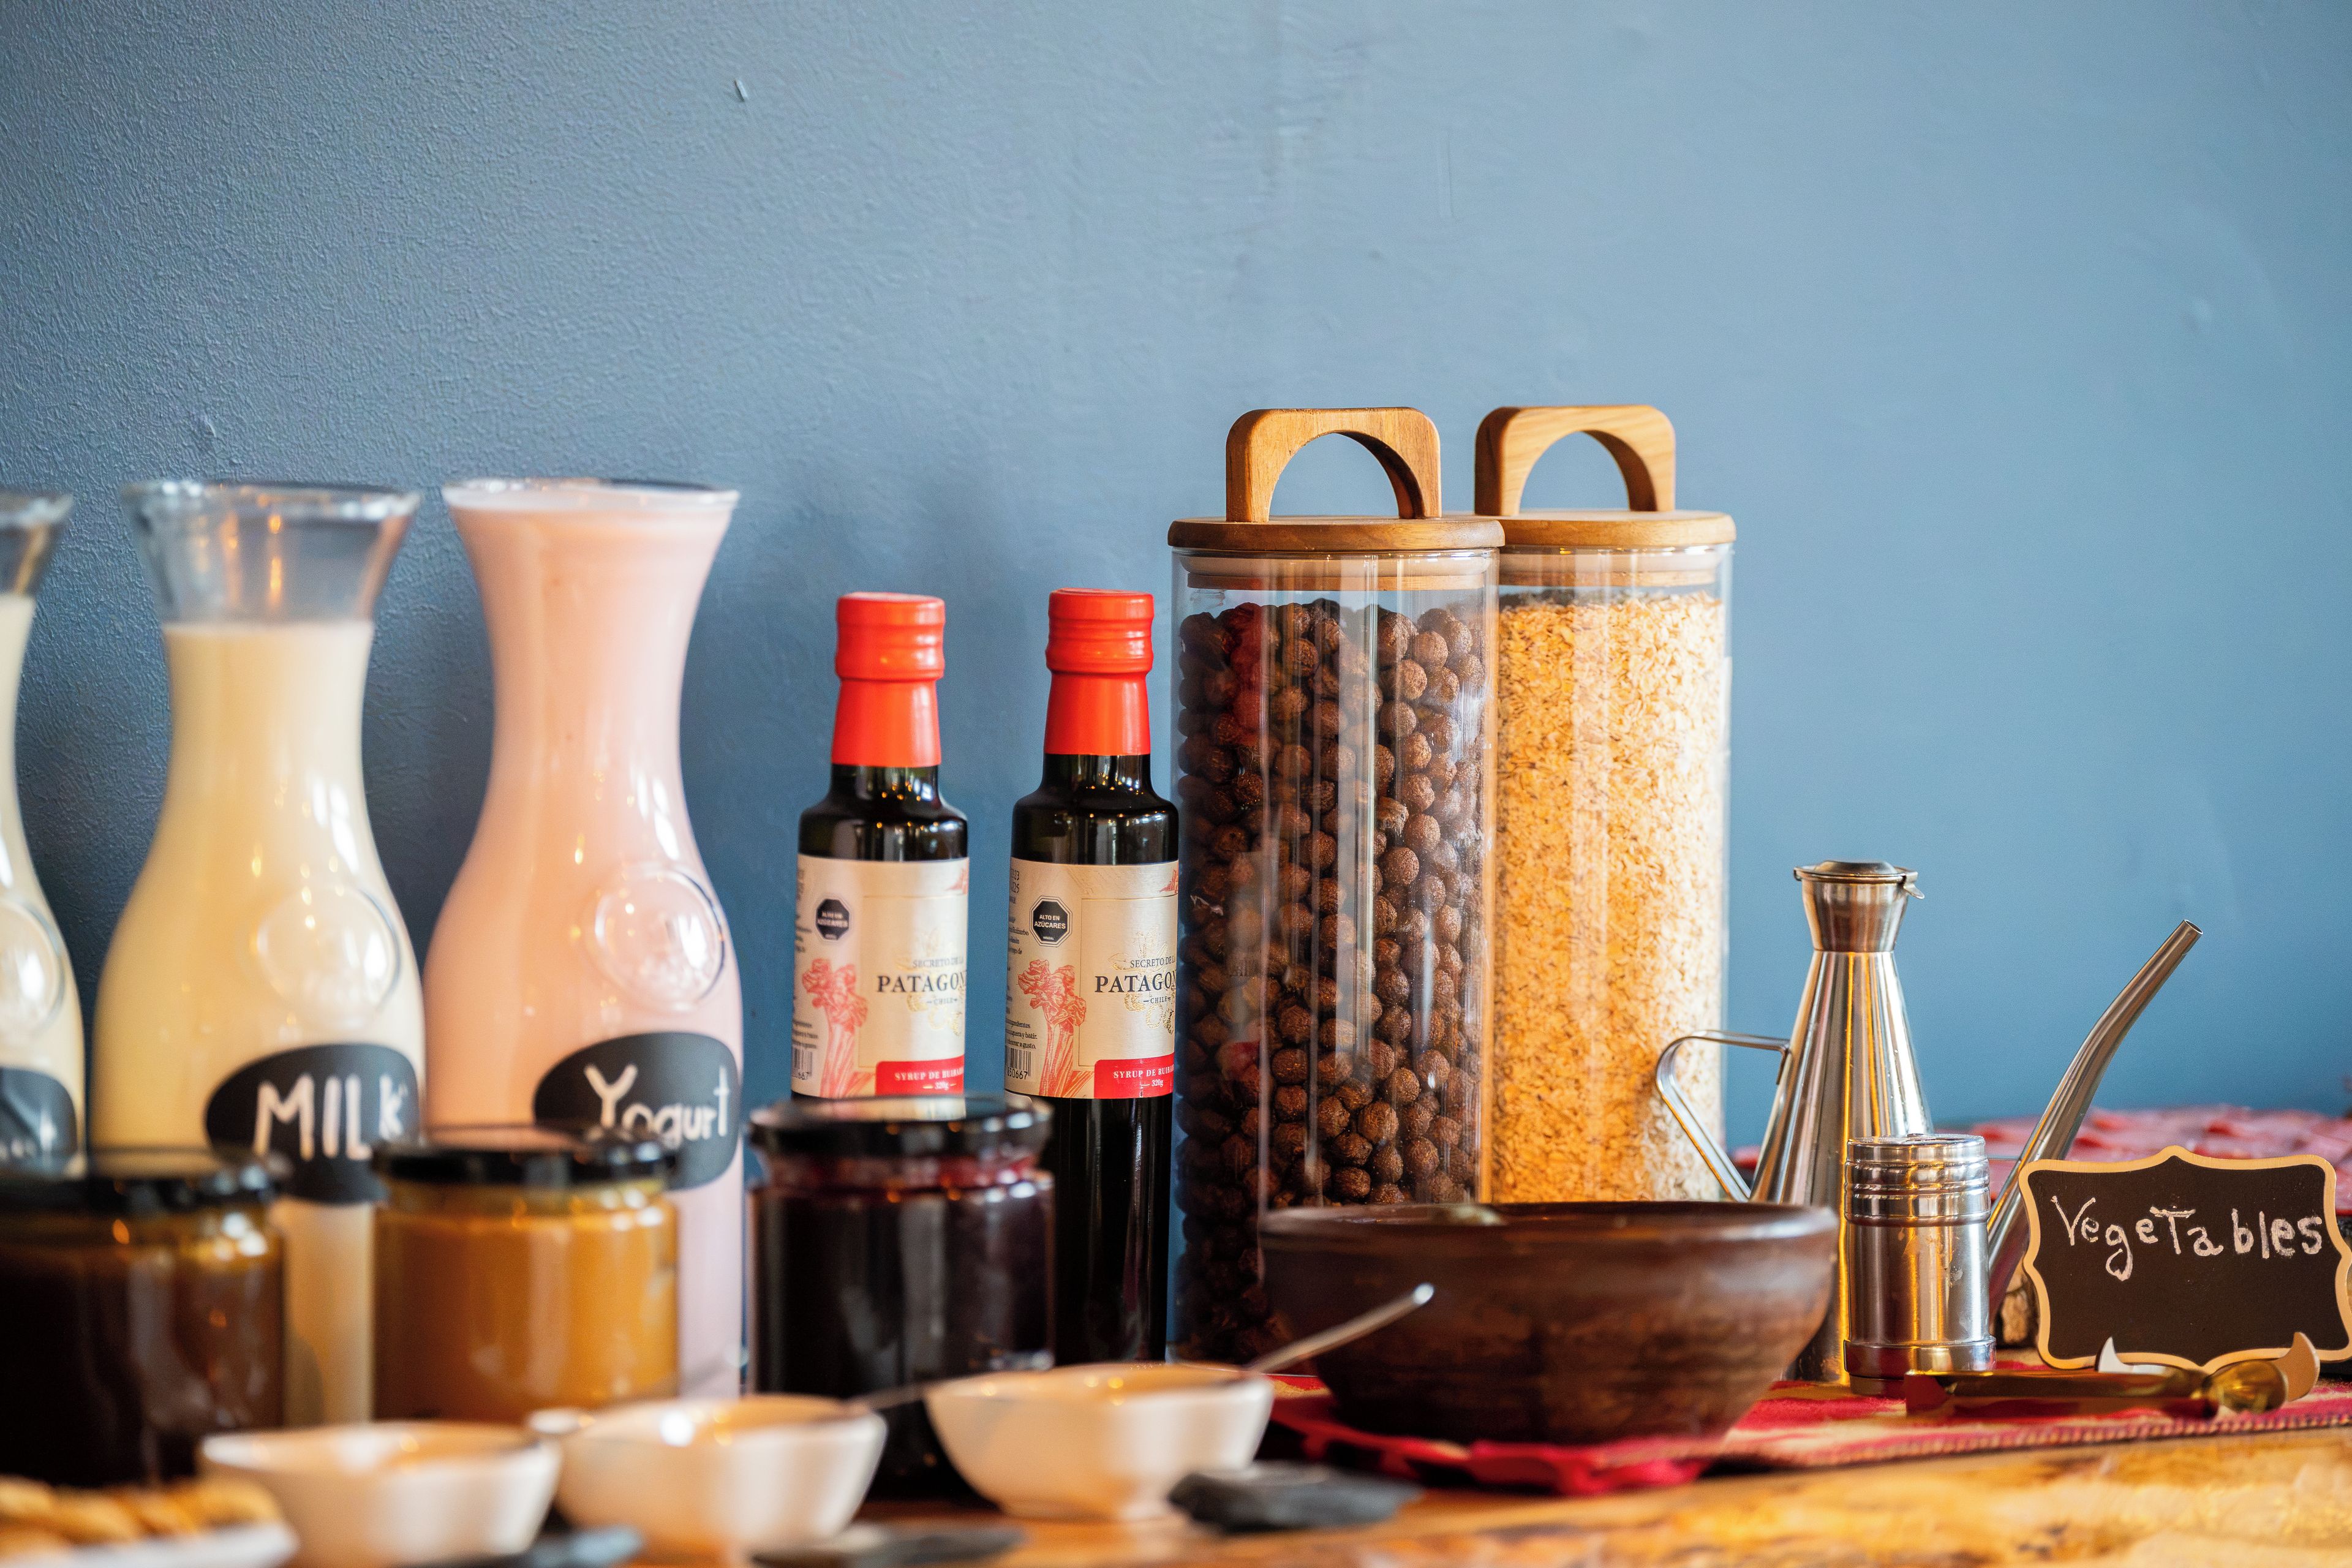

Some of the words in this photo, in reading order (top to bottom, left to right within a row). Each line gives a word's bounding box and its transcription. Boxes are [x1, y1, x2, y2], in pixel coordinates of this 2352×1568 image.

[913, 958, 949, 968] SECRETO
[1130, 957, 1164, 968] SECRETO
[1165, 956, 1171, 965] DE
[894, 1071, 926, 1081] SYRUP
[929, 1071, 940, 1079] DE
[1114, 1070, 1144, 1079] SYRUP
[1152, 1079, 1164, 1088] 320g
[584, 1063, 729, 1150] Yogurt
